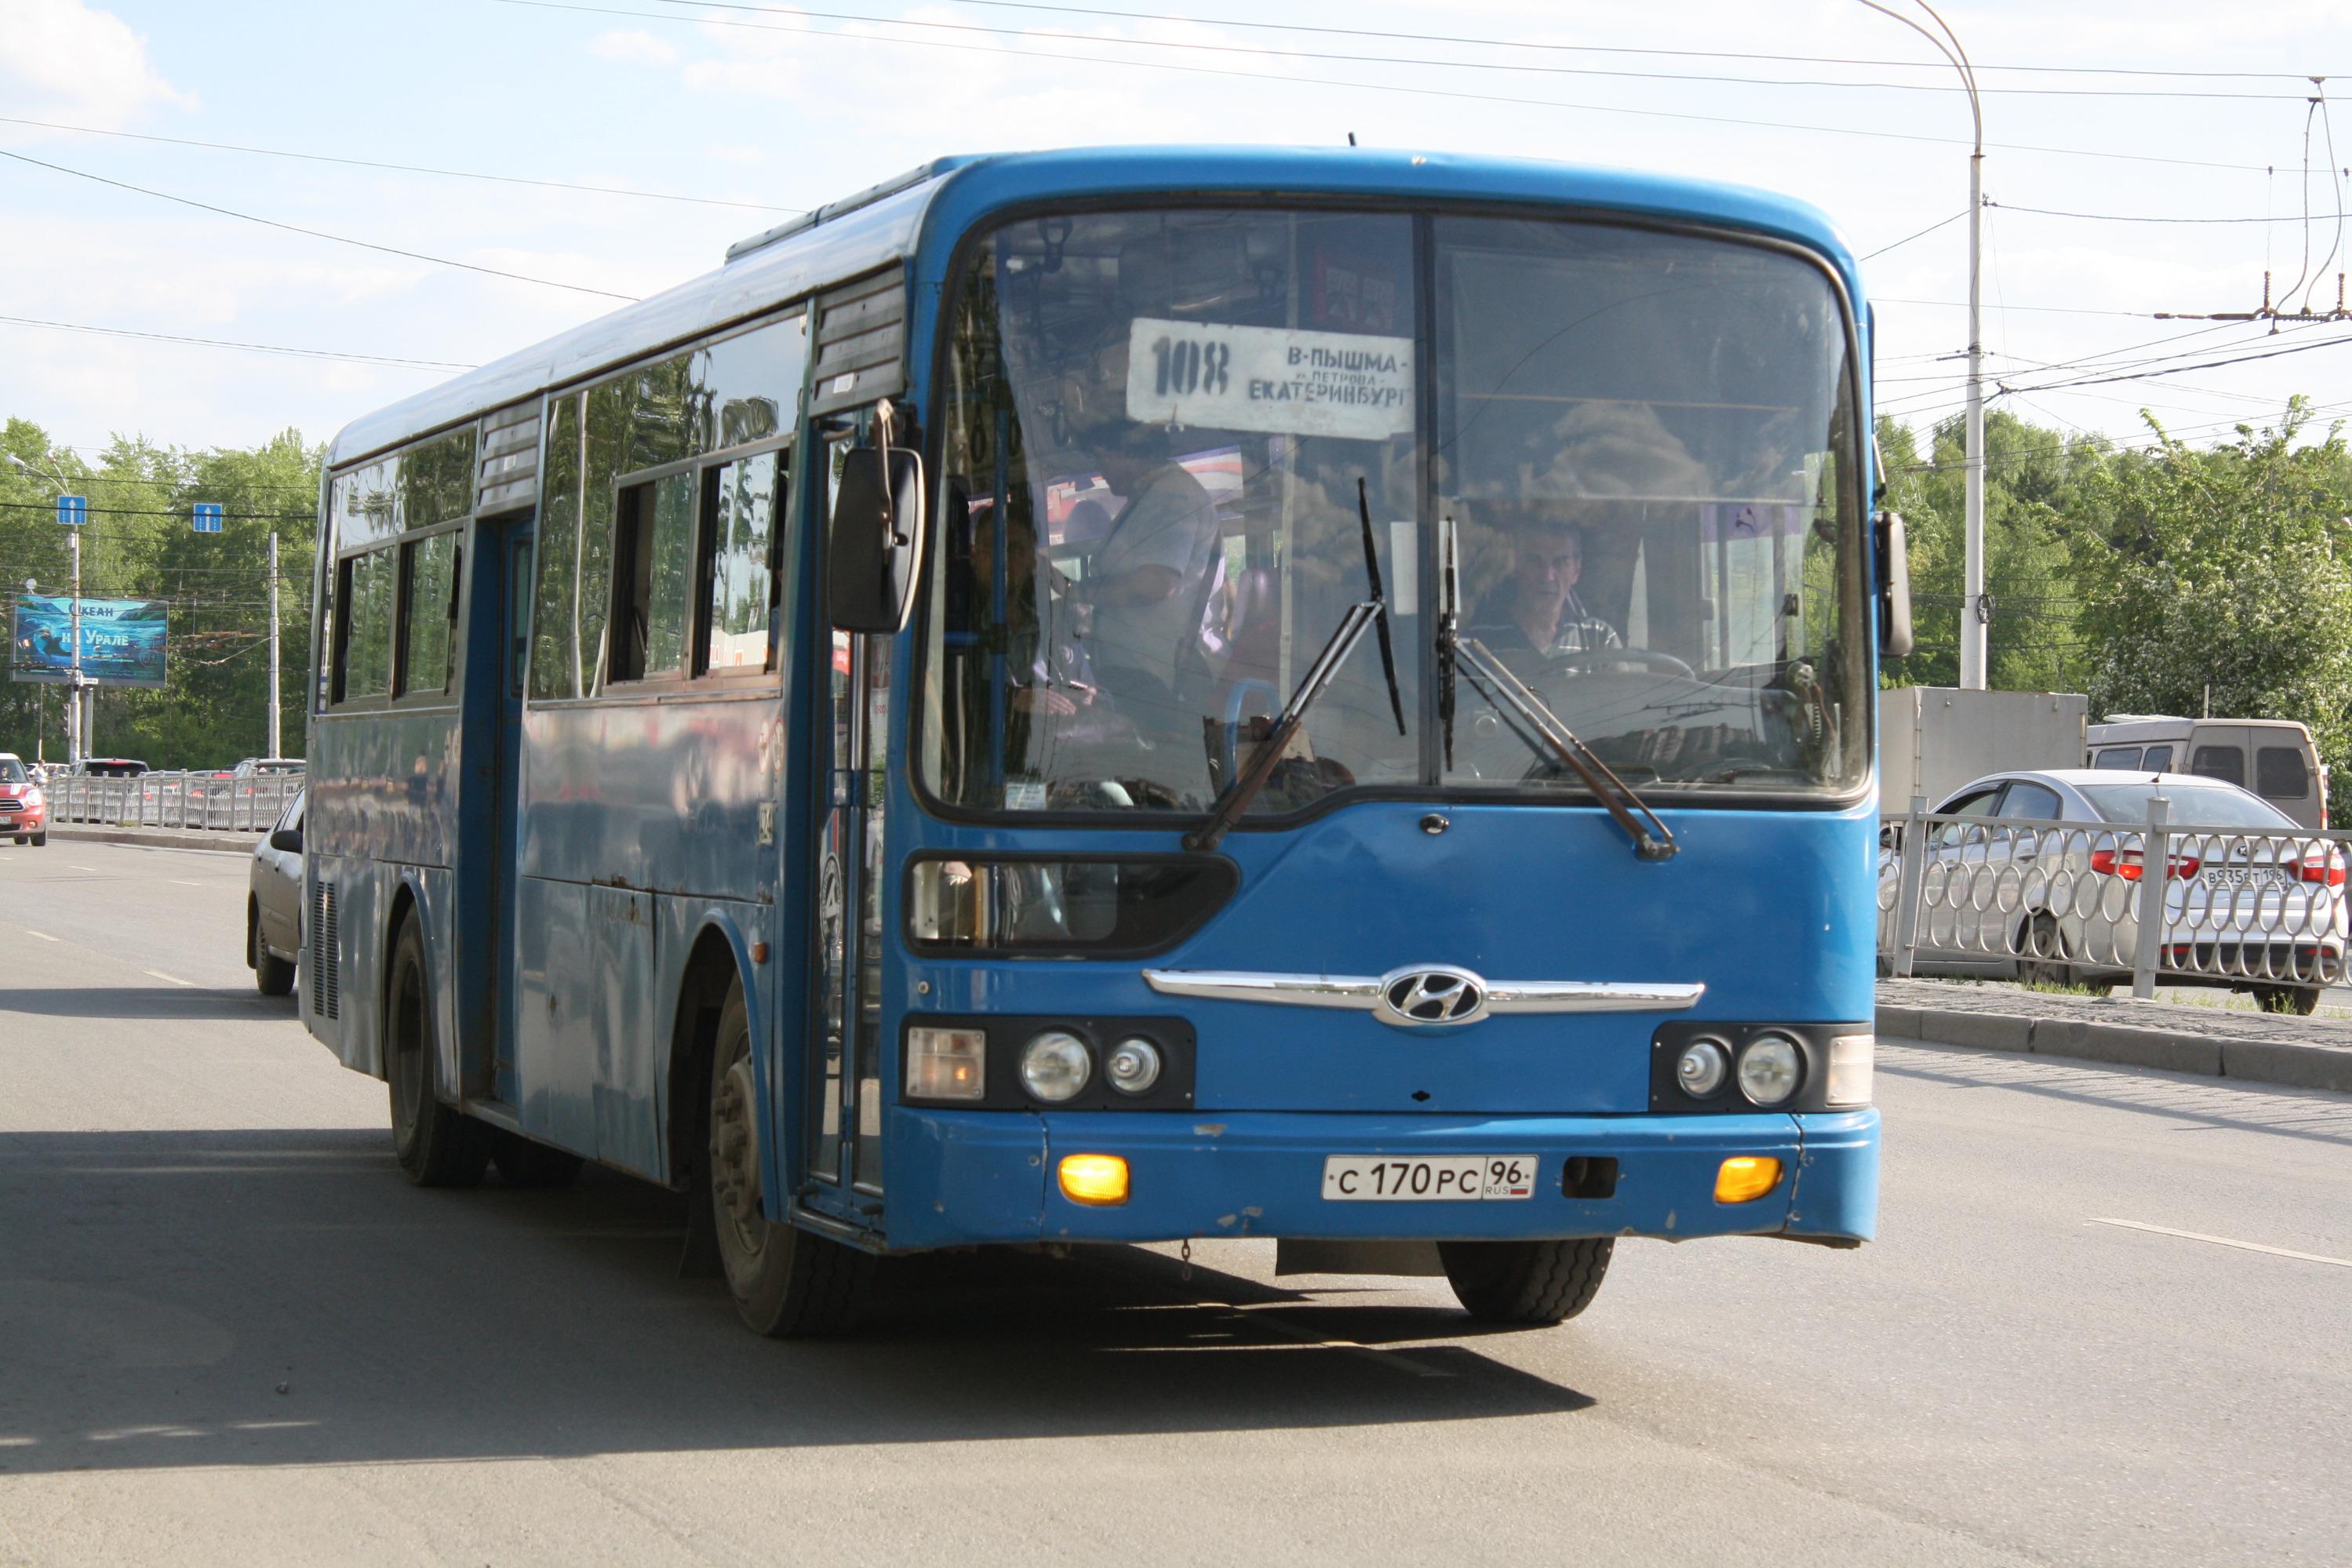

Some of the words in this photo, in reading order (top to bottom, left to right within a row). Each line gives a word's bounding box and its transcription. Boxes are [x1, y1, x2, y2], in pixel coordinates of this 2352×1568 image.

[1152, 336, 1229, 395] 108
[1249, 379, 1411, 408] ЕКАТЕРИНБУРГ
[1490, 1161, 1522, 1185] 96
[1485, 1186, 1509, 1195] RUS
